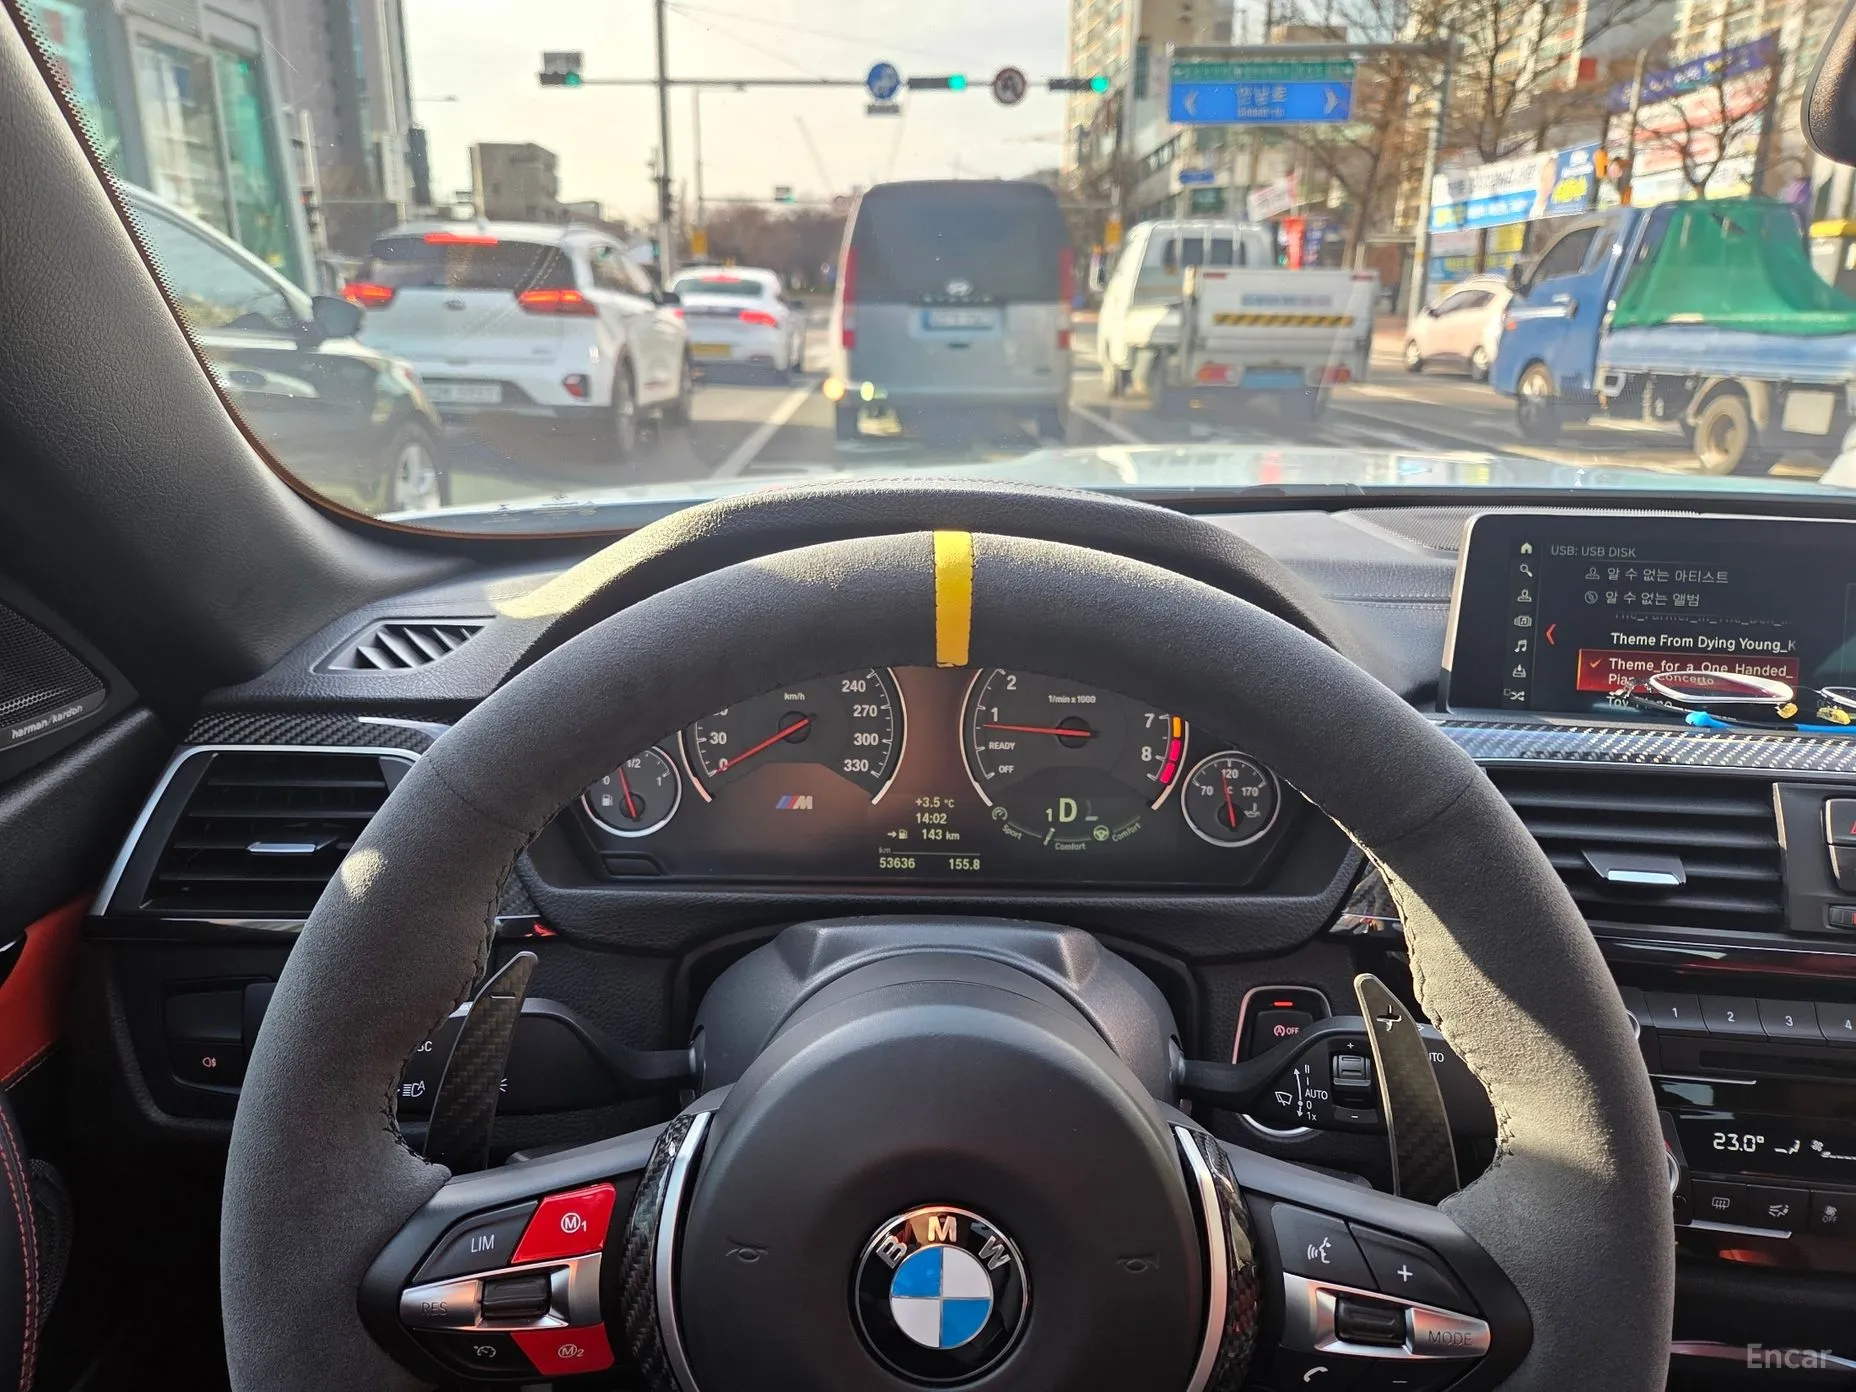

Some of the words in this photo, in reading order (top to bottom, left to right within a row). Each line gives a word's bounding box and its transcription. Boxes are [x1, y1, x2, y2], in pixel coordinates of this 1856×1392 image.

[1551, 545, 1578, 556] USB:
[1581, 547, 1605, 557] USB
[1608, 547, 1636, 558] DISK
[1607, 567, 1620, 581] 알
[1625, 567, 1638, 581] 수
[1643, 568, 1670, 582] 없는
[1675, 569, 1729, 584] 아티스트
[1605, 591, 1618, 604] 알
[1623, 591, 1636, 605] 수
[1641, 592, 1668, 606] 없는
[1672, 593, 1700, 607] 앨범
[1610, 632, 1656, 646] Theme
[1660, 634, 1693, 647] From
[1698, 636, 1736, 652] Dying
[841, 680, 867, 693] 240
[1006, 675, 1017, 690] 2
[784, 692, 805, 701] km/h
[1077, 695, 1097, 704] 1000
[853, 705, 878, 717] 270
[991, 707, 999, 722] 1
[1144, 713, 1155, 728] 7
[709, 732, 727, 744] 30
[853, 733, 879, 746] 300
[988, 741, 1016, 751] READY
[1141, 746, 1152, 761] 8
[626, 758, 641, 769] 1/2
[719, 758, 729, 770] 0
[843, 759, 869, 772] 330
[998, 765, 1014, 774] OFF
[1221, 769, 1239, 779] 120
[602, 776, 610, 785] 0
[656, 777, 662, 786] 1
[1200, 785, 1214, 796] 70
[1241, 787, 1259, 797] 170
[915, 797, 940, 808] +3.5
[1046, 808, 1053, 822] 1
[1059, 797, 1078, 823] D
[916, 812, 947, 824] 14:02
[921, 829, 942, 840] 143
[945, 831, 960, 840] km
[1002, 824, 1023, 841] Sport
[1112, 823, 1142, 842] Comfort
[878, 846, 891, 854] km
[1055, 842, 1086, 851] Comfort
[879, 857, 916, 869] 53636
[949, 858, 980, 870] 155.8
[1671, 1007, 1678, 1018] 1
[1727, 1011, 1735, 1023] 2
[1785, 1015, 1794, 1027] 3
[1844, 1019, 1853, 1031] 4
[1286, 1027, 1299, 1035] OFF
[1304, 1089, 1328, 1100] AUTO
[1306, 1101, 1312, 1110] 0
[1307, 1112, 1317, 1121] 1x
[1822, 1216, 1838, 1224] OFF
[470, 1233, 495, 1254] LIM
[876, 1215, 1012, 1271] BMW
[421, 1300, 448, 1317] RES
[1428, 1329, 1473, 1346] MODE
